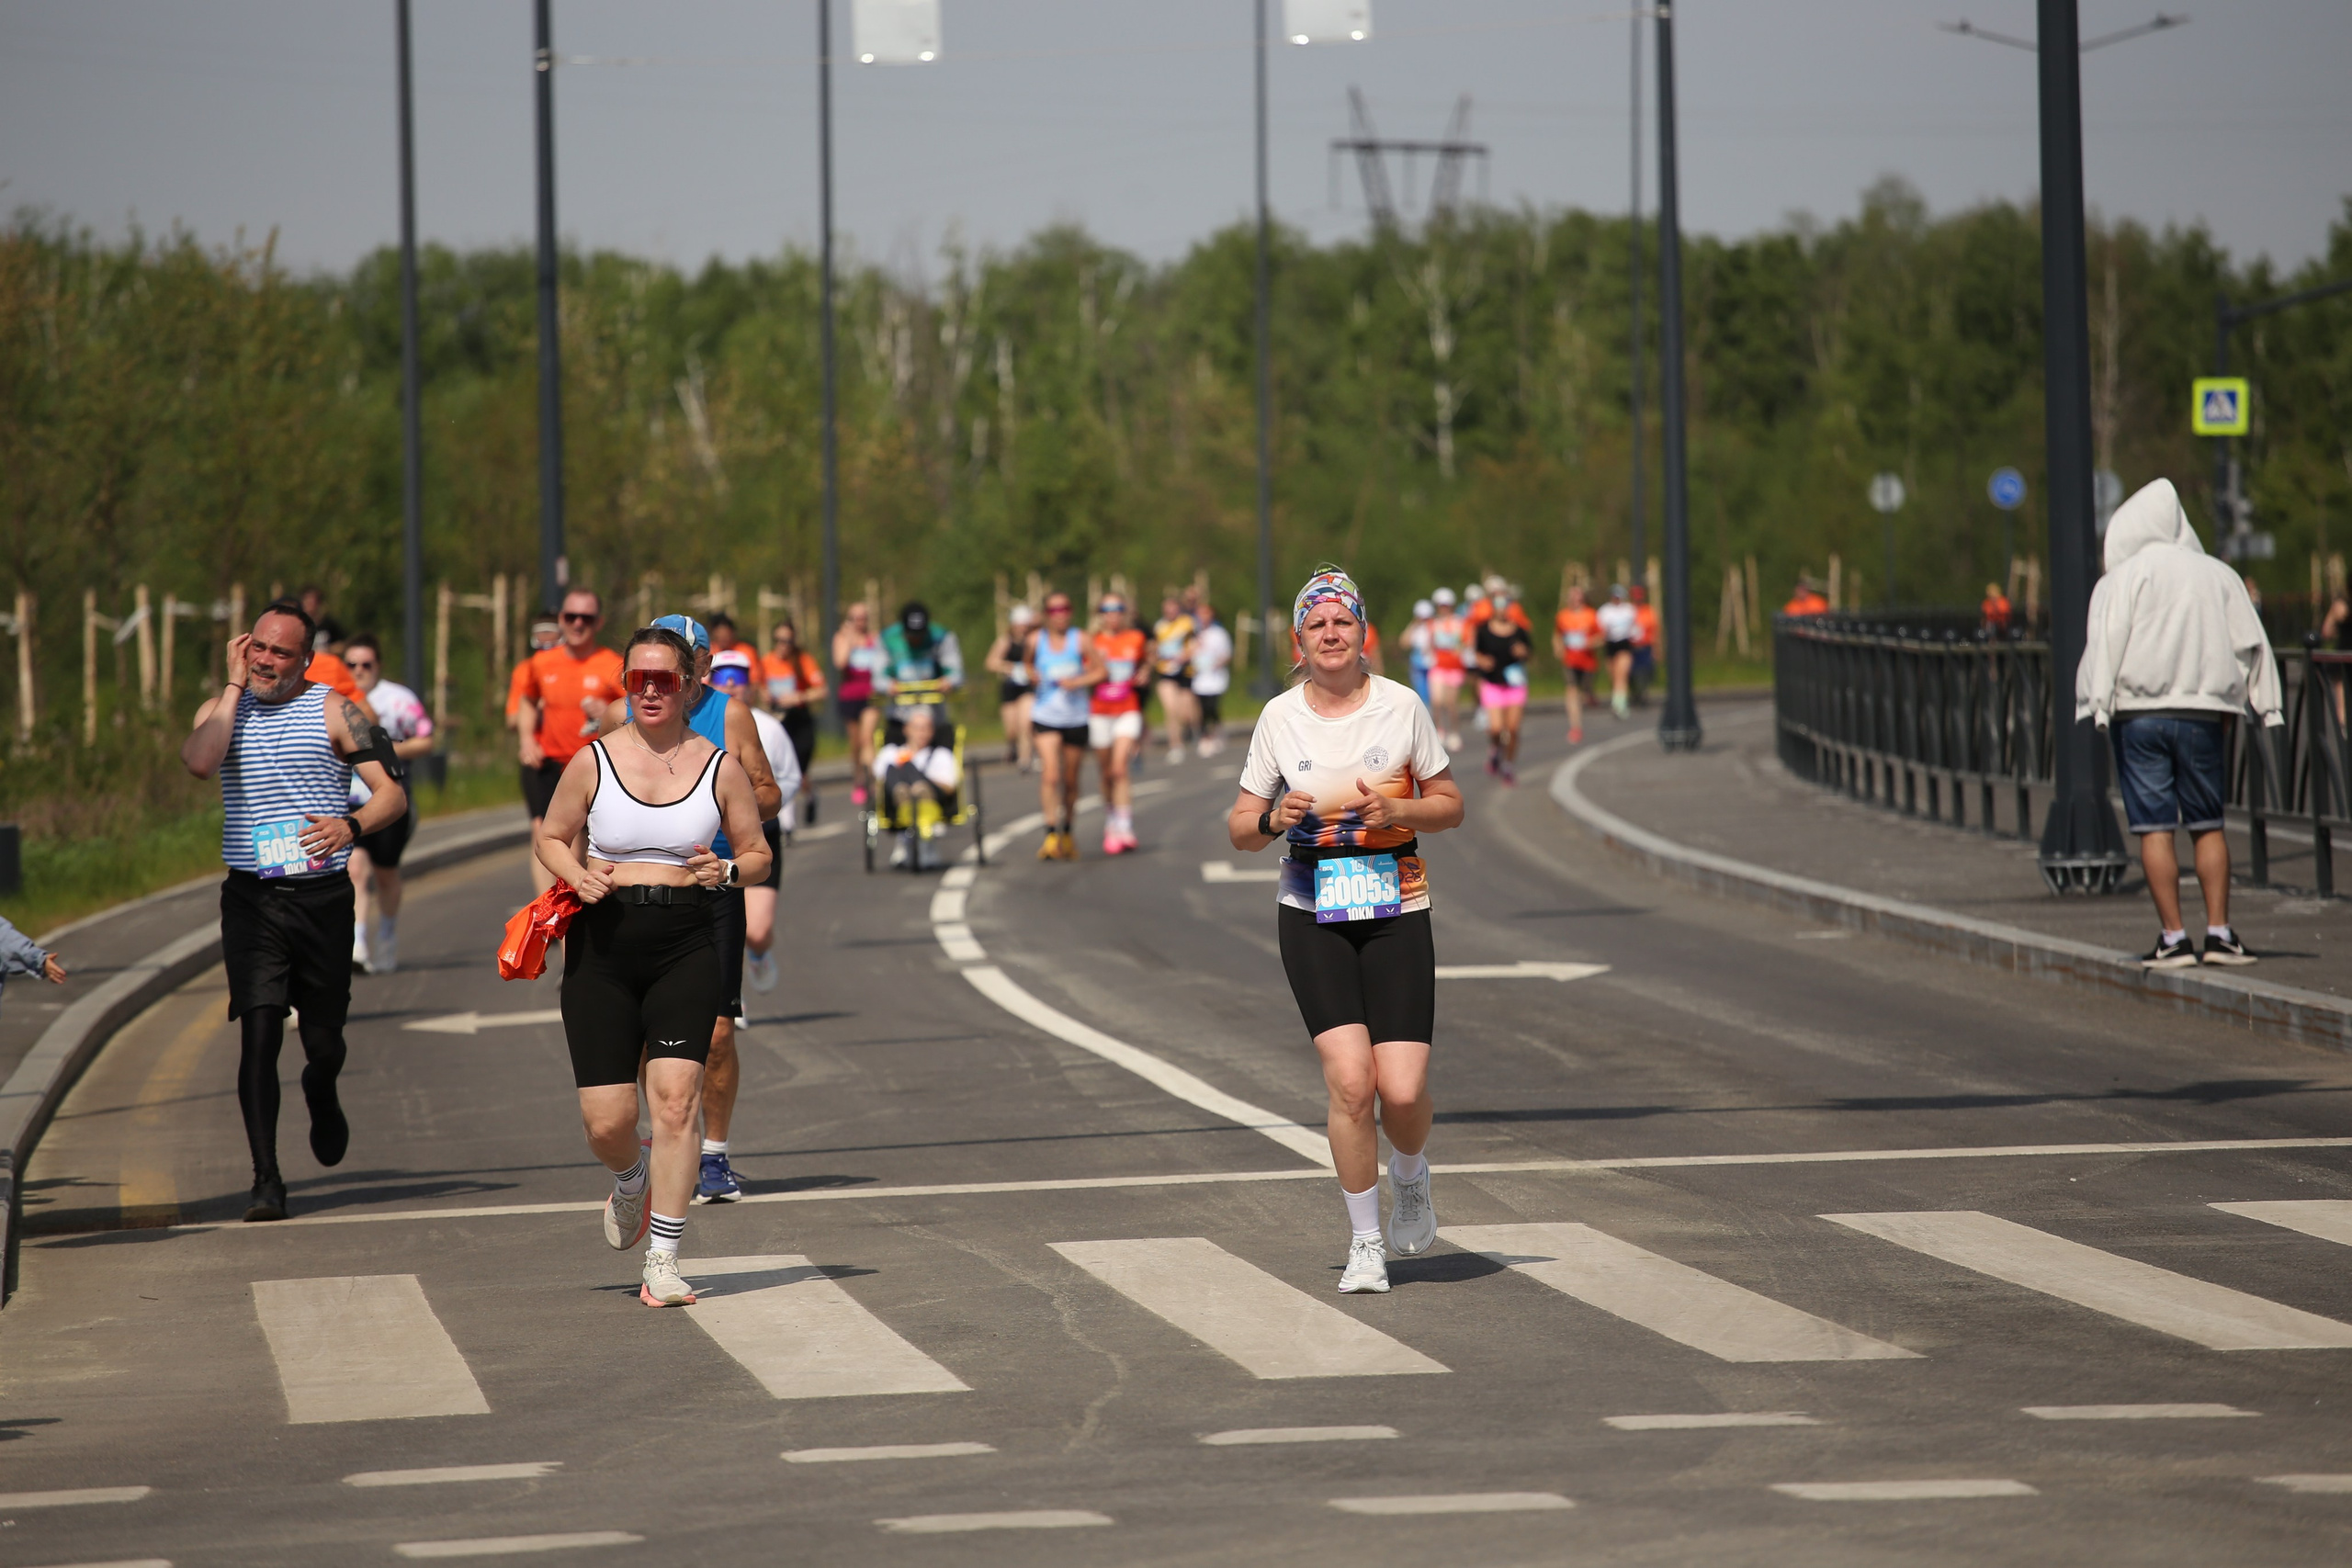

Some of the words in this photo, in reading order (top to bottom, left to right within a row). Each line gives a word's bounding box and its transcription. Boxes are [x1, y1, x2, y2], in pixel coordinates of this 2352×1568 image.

[1298, 761, 1312, 772] GRi
[283, 861, 309, 875] 10KM
[1320, 872, 1395, 908] 50053
[1346, 906, 1375, 921] 10KM
